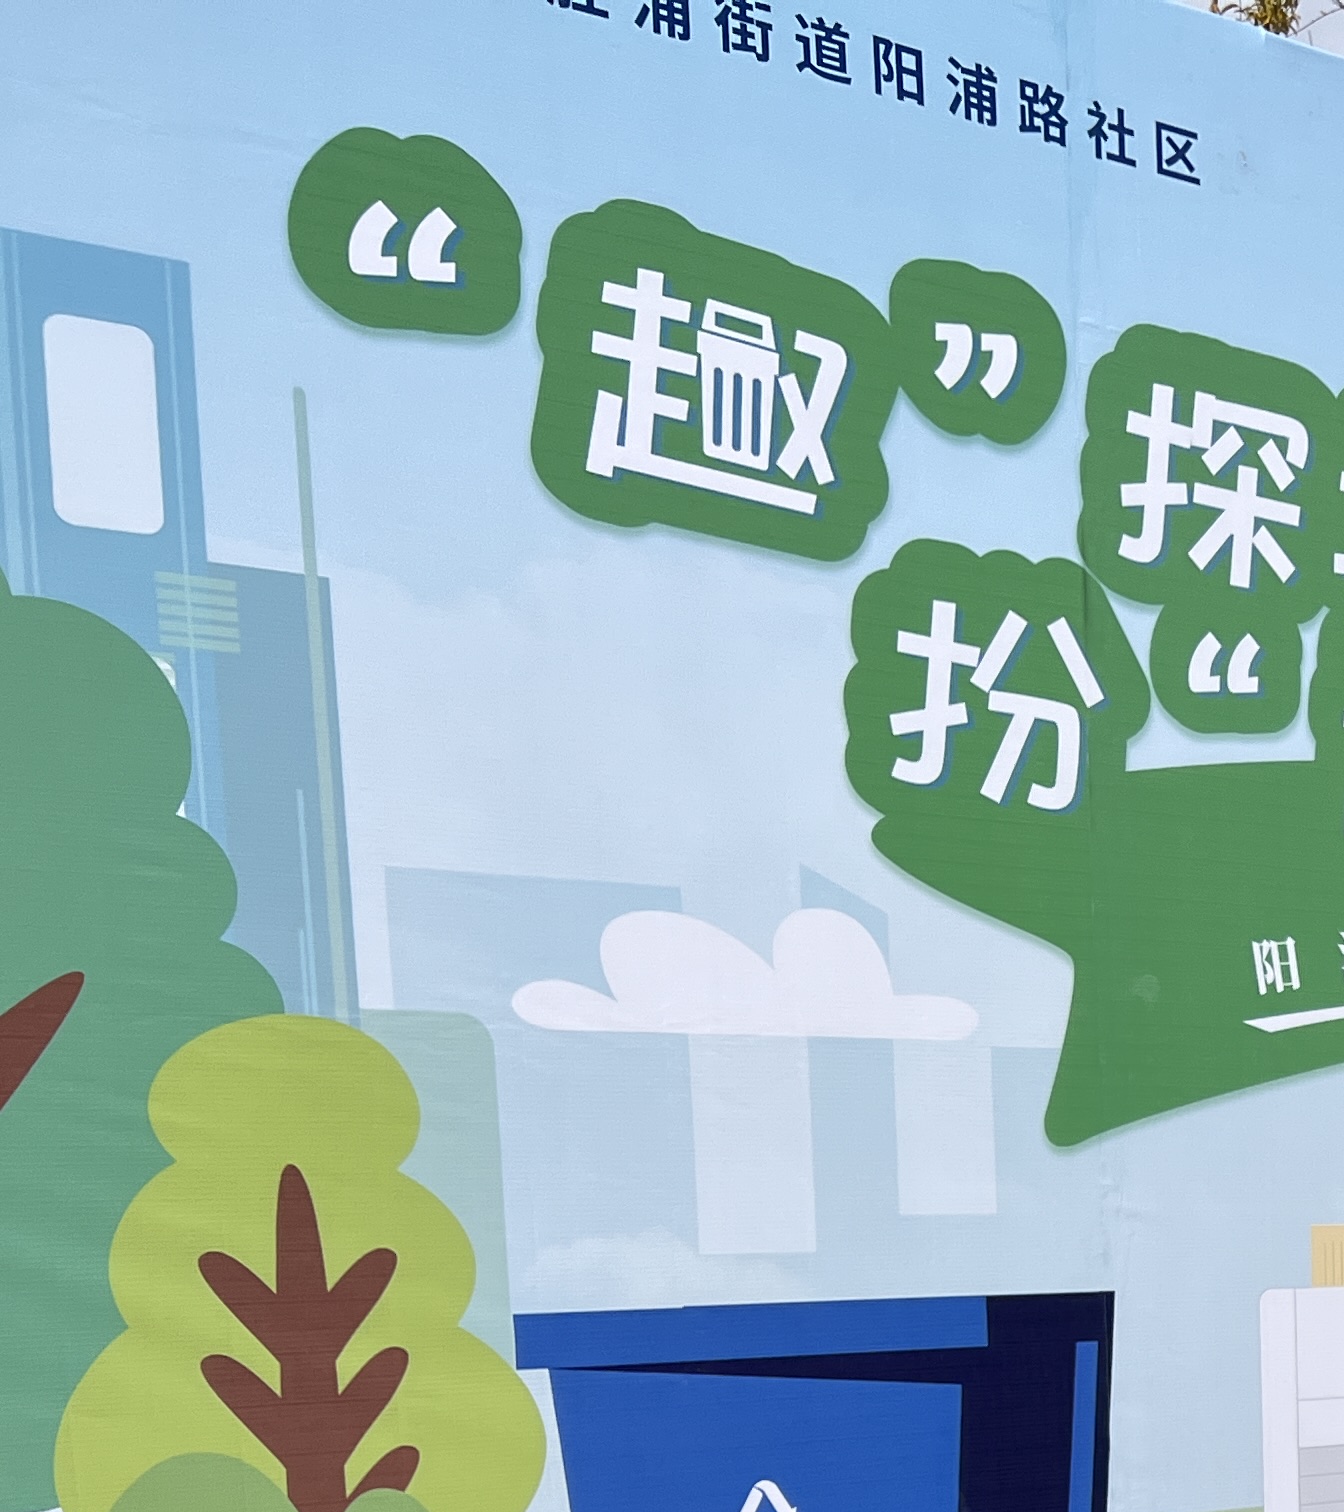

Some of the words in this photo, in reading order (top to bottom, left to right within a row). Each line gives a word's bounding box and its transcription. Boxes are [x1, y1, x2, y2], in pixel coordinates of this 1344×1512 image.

[546, 0, 1202, 187] 浦街道阳浦路社区
